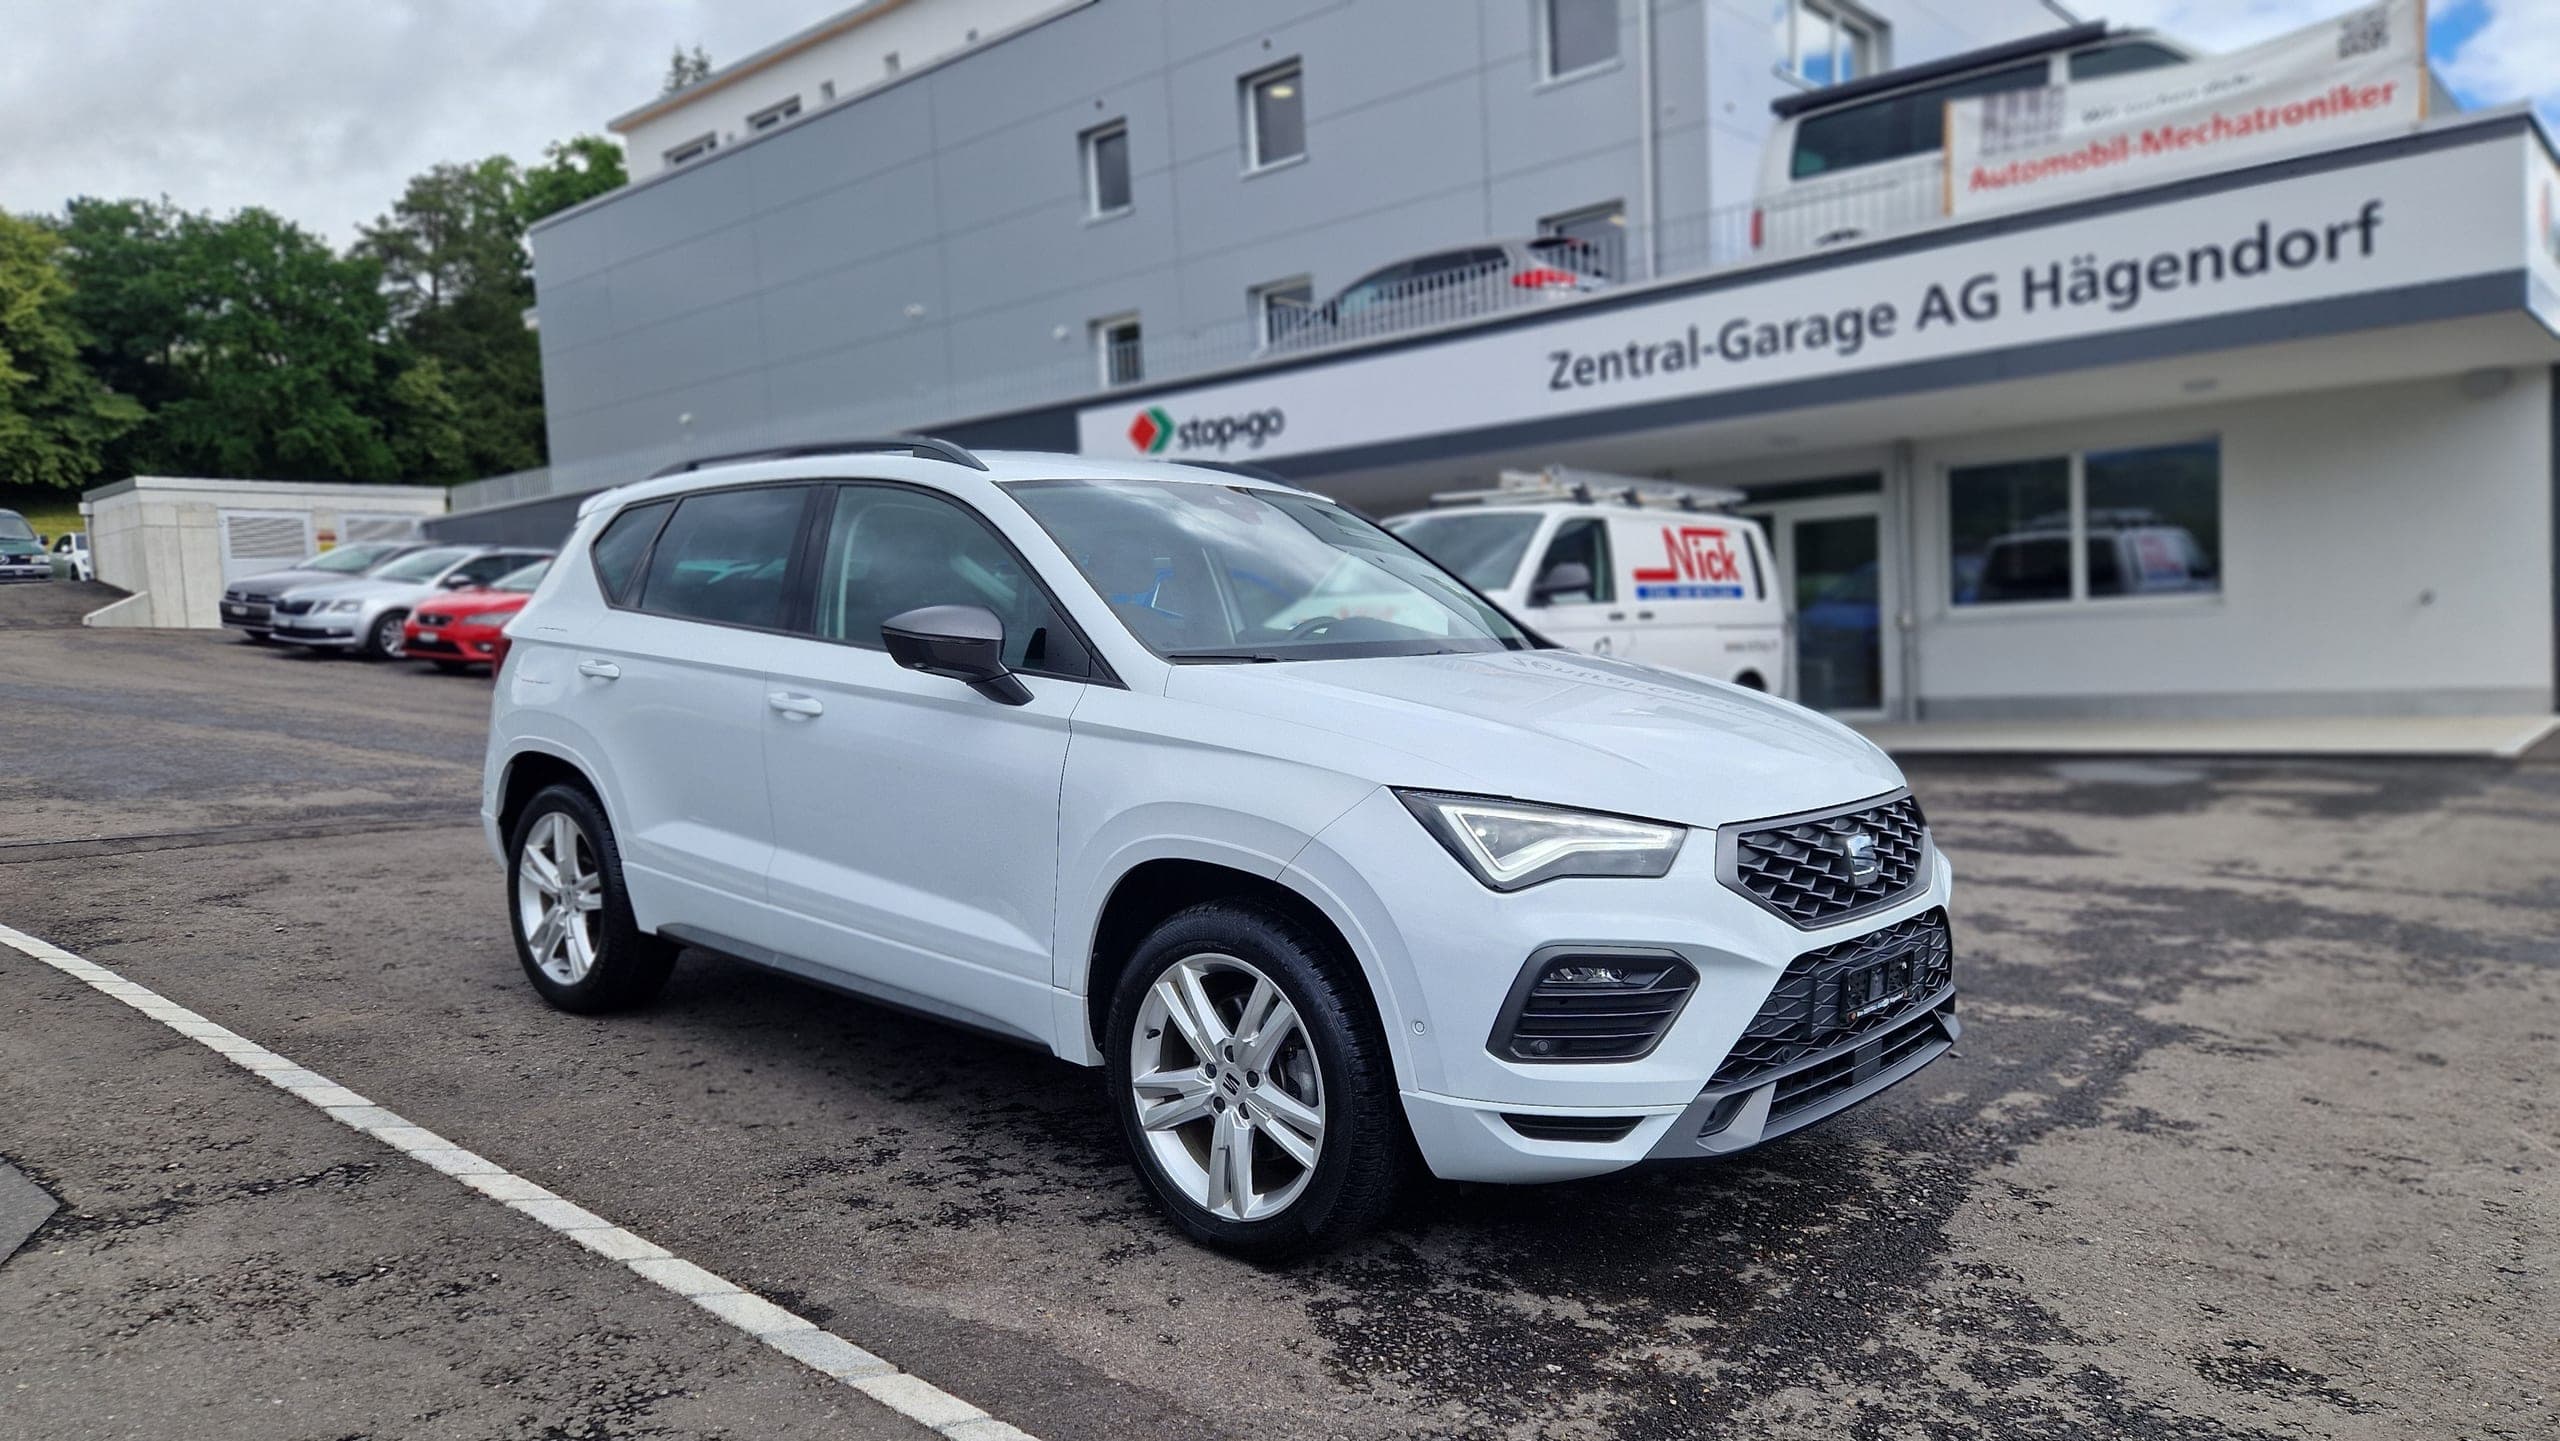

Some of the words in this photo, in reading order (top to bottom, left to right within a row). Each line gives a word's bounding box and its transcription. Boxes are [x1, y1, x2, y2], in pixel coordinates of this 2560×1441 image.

[1969, 81, 2398, 192] Automobil-Mechatroniker
[1548, 302, 1897, 391] Zentral-Garage
[1915, 271, 2000, 331] AG
[2021, 200, 2382, 311] Hägendorf
[1634, 527, 1741, 581] Nick
